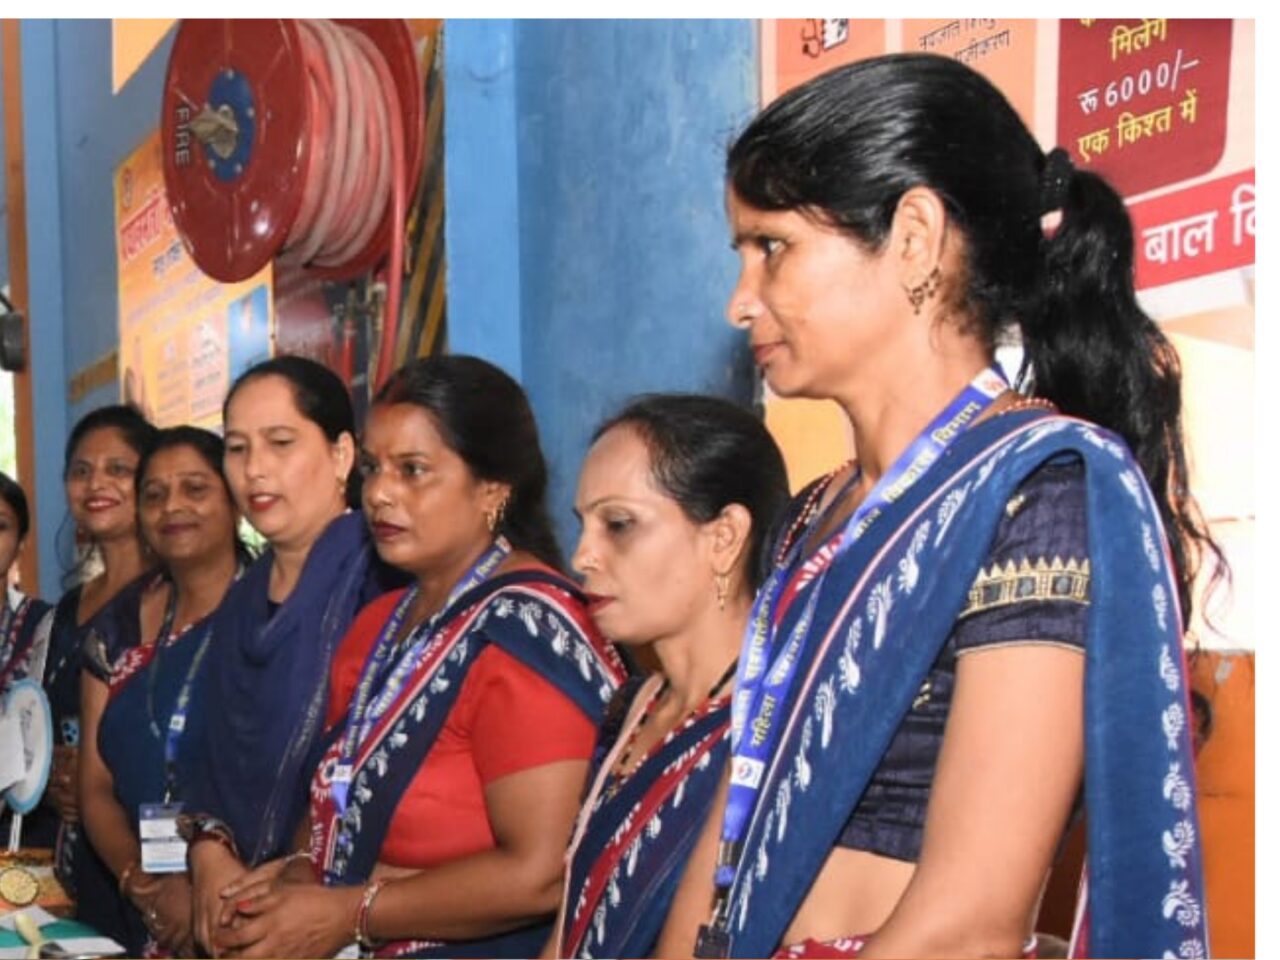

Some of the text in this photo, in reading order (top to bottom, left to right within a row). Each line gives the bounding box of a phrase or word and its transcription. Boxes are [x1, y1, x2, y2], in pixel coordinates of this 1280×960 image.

[175, 107, 190, 166] FIRE
[1078, 88, 1198, 162] एक किश्त में
[1142, 210, 1218, 263] बाल
